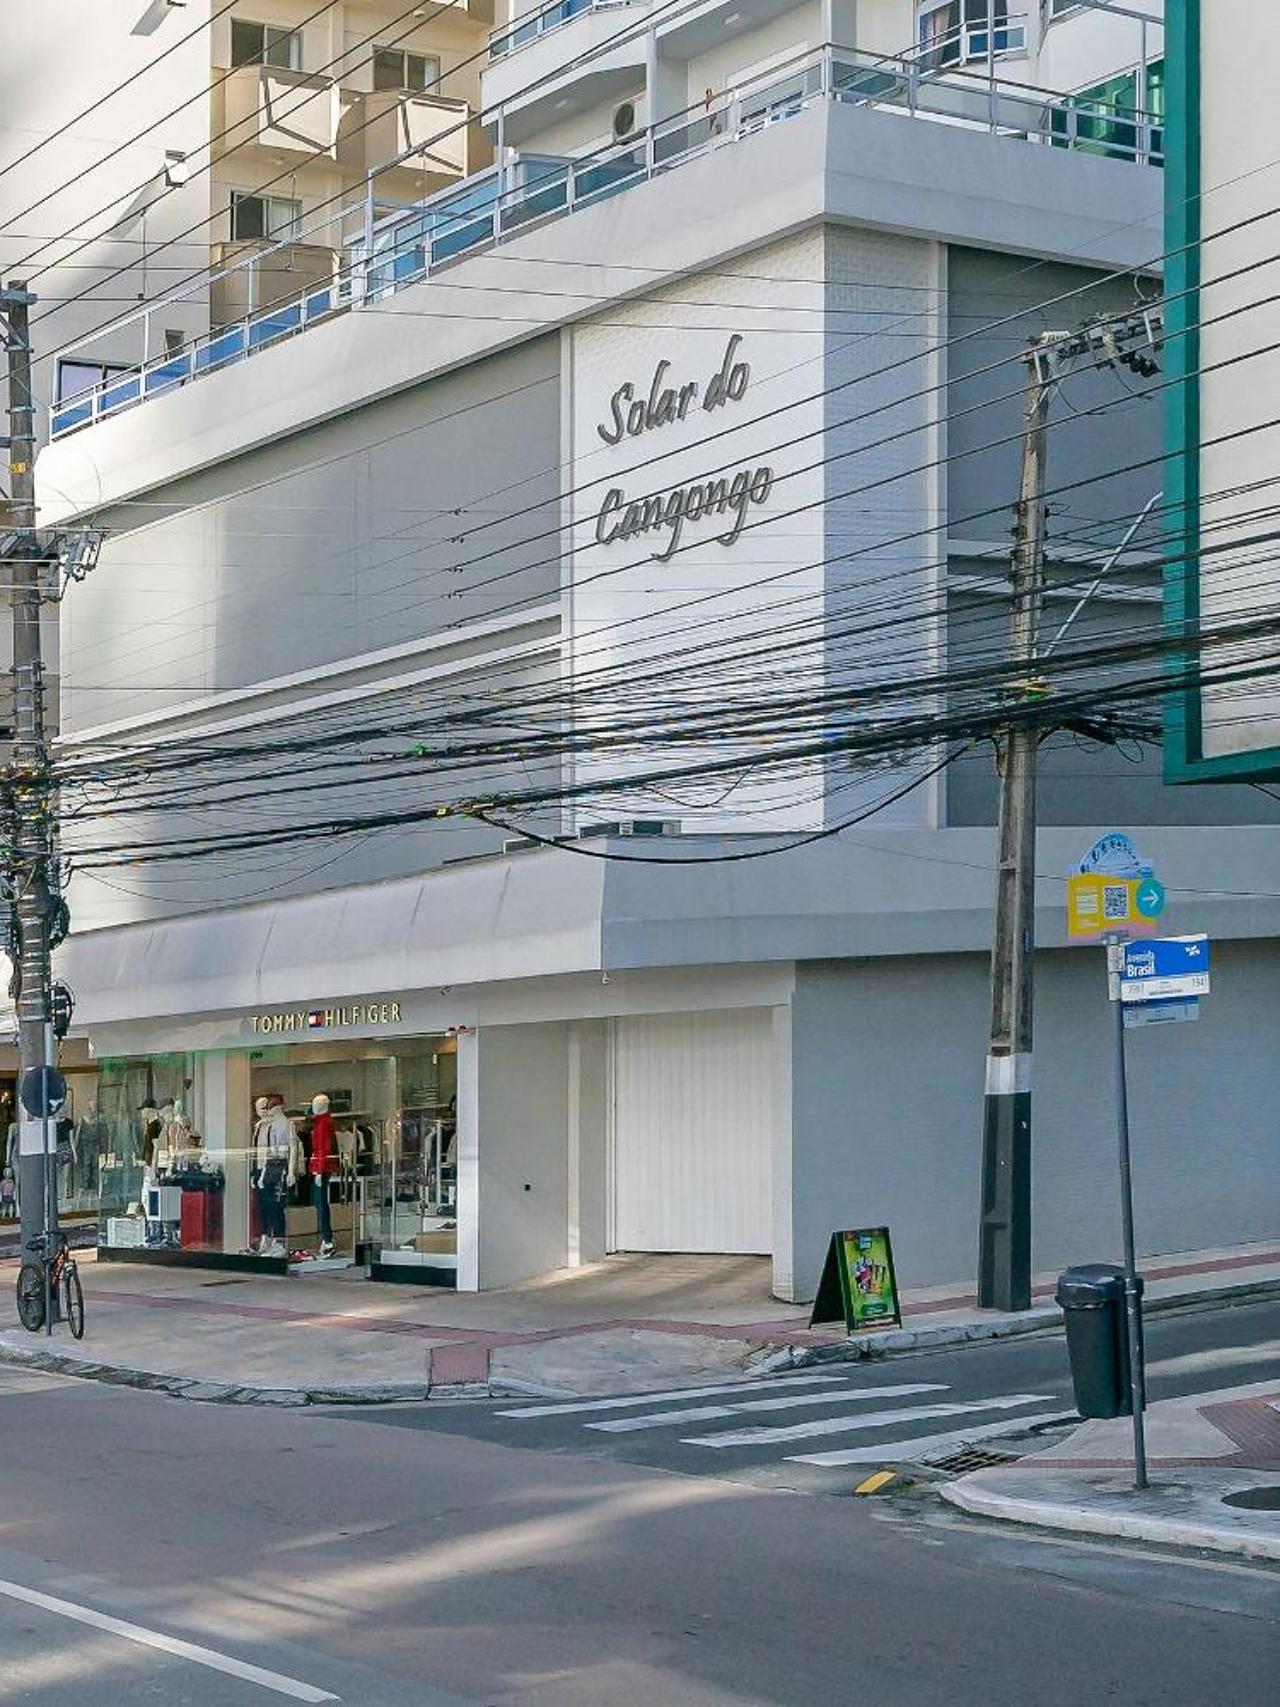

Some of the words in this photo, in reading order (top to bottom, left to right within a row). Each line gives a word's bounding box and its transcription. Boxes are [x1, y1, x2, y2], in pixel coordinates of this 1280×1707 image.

[596, 359, 699, 446] Solar
[703, 333, 751, 413] do
[595, 466, 775, 563] Cangongo
[1127, 959, 1156, 978] Brasil
[251, 1013, 308, 1034] TOMMY
[324, 1003, 402, 1028] HILFIGER
